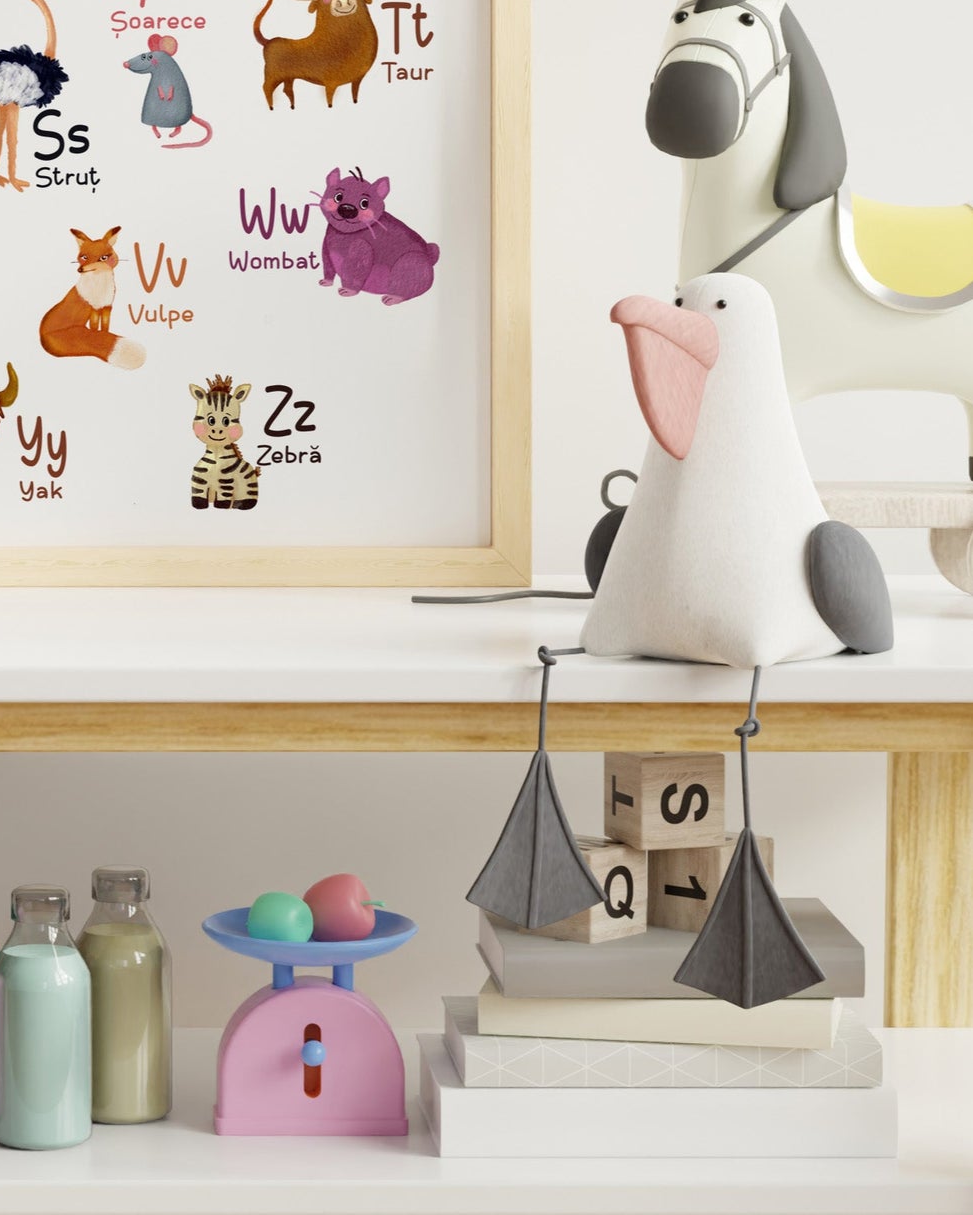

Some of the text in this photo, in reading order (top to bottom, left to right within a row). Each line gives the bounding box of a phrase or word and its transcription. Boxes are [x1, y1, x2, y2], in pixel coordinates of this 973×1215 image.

[110, 11, 206, 38] Șoarece
[381, 2, 434, 54] Tt
[381, 62, 434, 82] Taur
[33, 109, 90, 161] Ss
[36, 167, 100, 193] Struț
[239, 187, 310, 240] Ww
[134, 242, 188, 294] Vv
[228, 251, 320, 272] Wombat
[128, 304, 194, 329] Vulpe
[265, 384, 316, 437] Zz
[17, 416, 67, 478] Yy
[256, 445, 322, 467] Zebră
[19, 481, 62, 501] Yak
[612, 774, 633, 816] T
[660, 783, 708, 824] S
[604, 865, 634, 919] Q
[664, 875, 706, 901] 1
